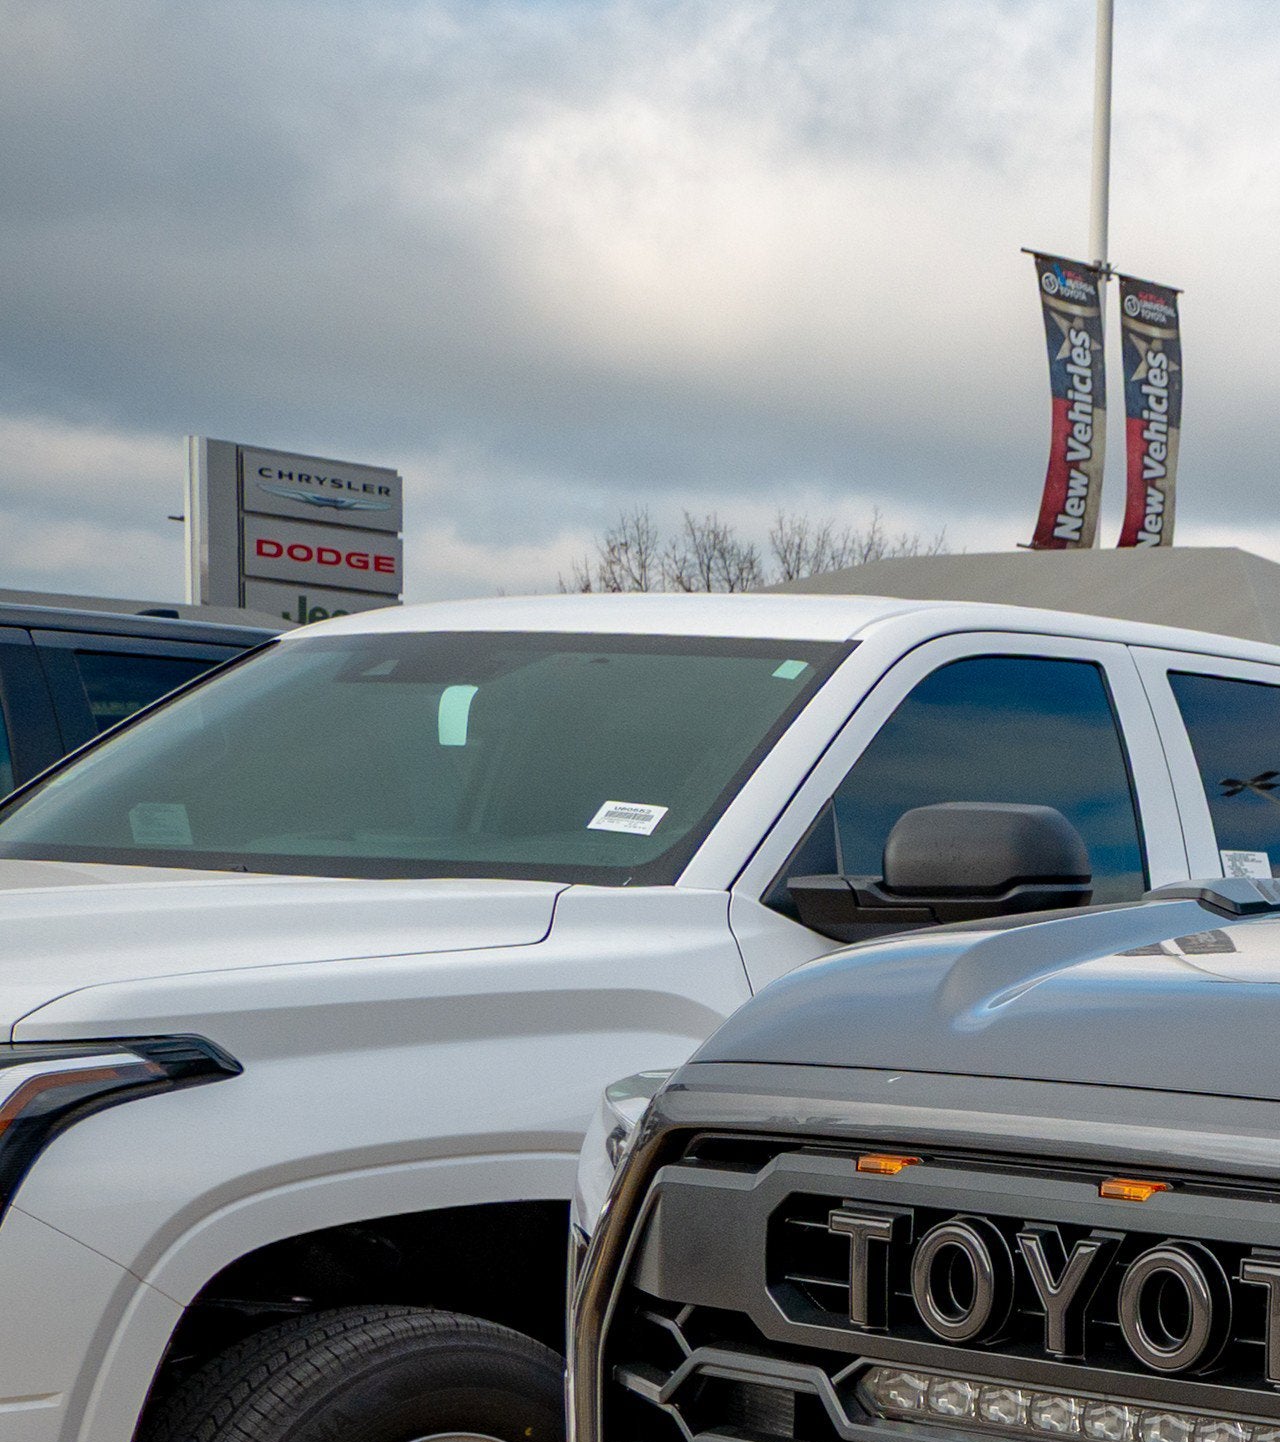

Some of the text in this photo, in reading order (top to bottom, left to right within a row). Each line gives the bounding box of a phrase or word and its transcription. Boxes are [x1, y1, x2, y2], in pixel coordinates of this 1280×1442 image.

[1053, 328, 1093, 541] New Vehicles
[1141, 351, 1169, 480] Vehicles
[257, 467, 392, 497] CHRYSLER
[256, 539, 395, 574] DODGE
